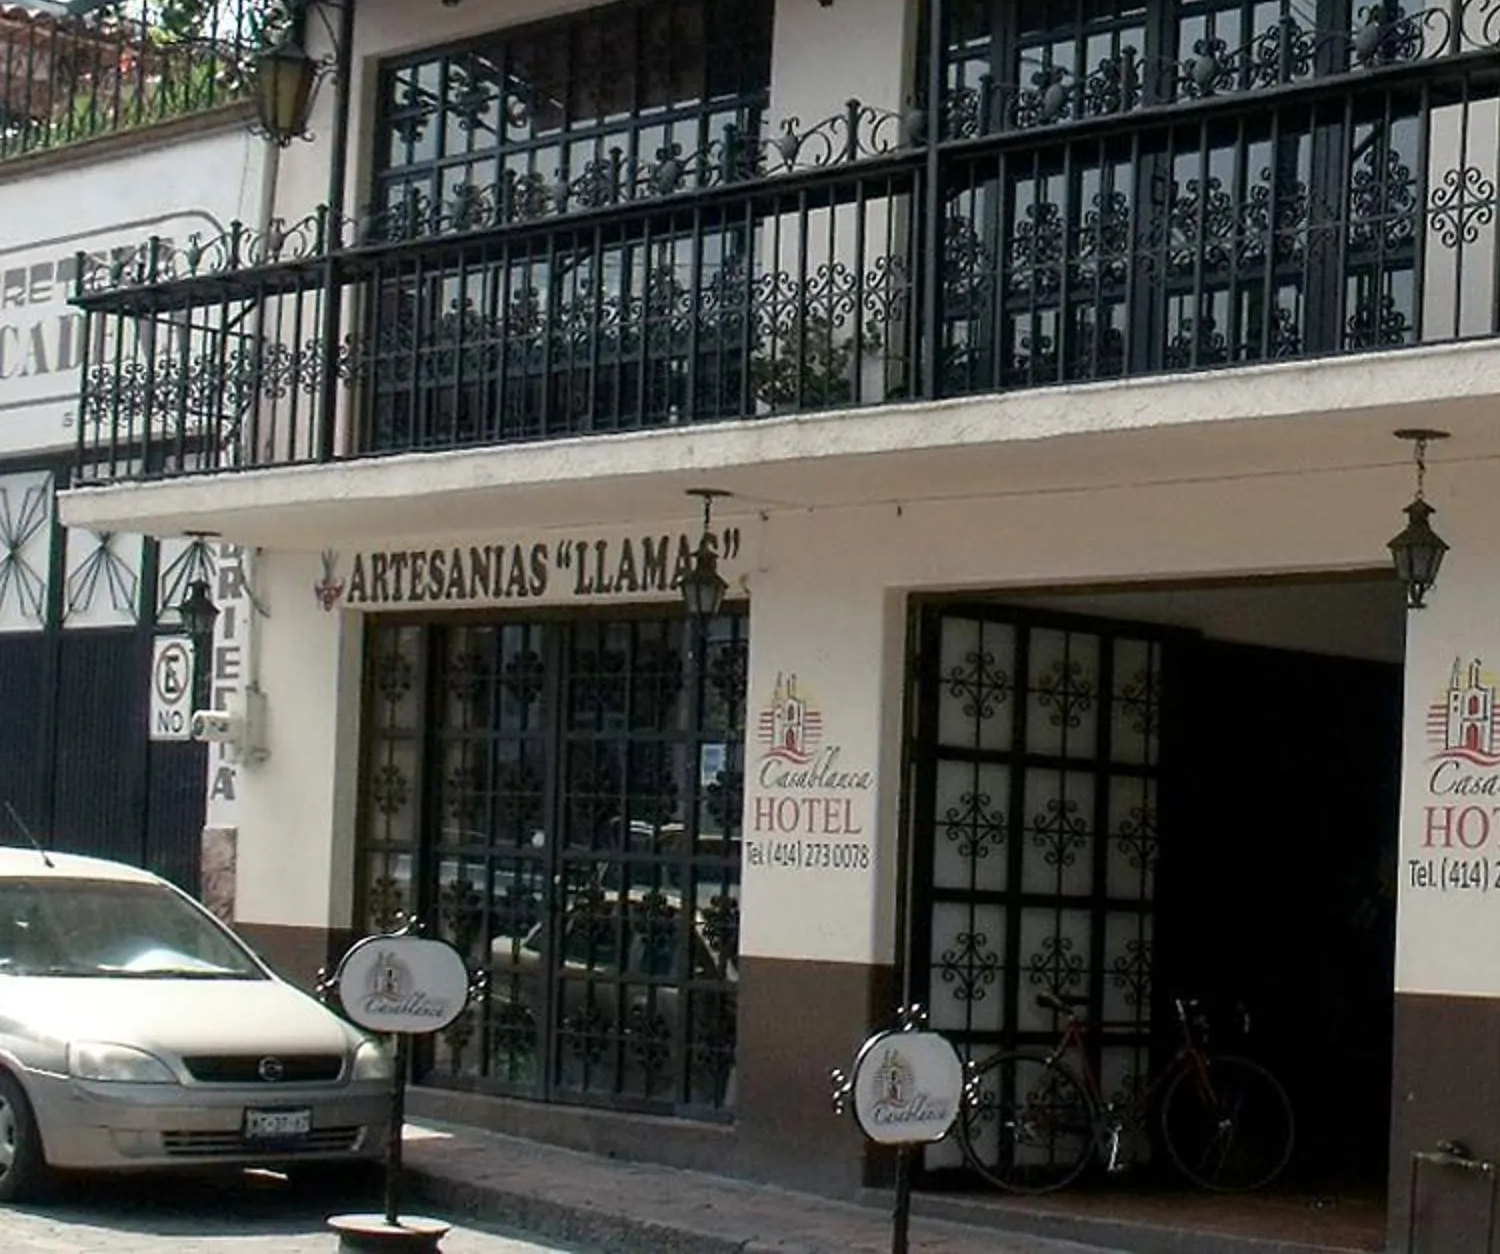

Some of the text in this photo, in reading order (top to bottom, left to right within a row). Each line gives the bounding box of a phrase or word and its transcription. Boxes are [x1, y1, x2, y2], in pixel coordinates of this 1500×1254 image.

[346, 542, 549, 604] ARTESANIAS
[158, 710, 183, 733] NO
[758, 745, 875, 791] Casablanca
[754, 796, 863, 835] HOTEL
[766, 840, 802, 870] (414)
[804, 844, 831, 867] 273
[832, 845, 871, 869] 0078
[1409, 860, 1437, 889] Tel.
[1440, 856, 1489, 892] (414)
